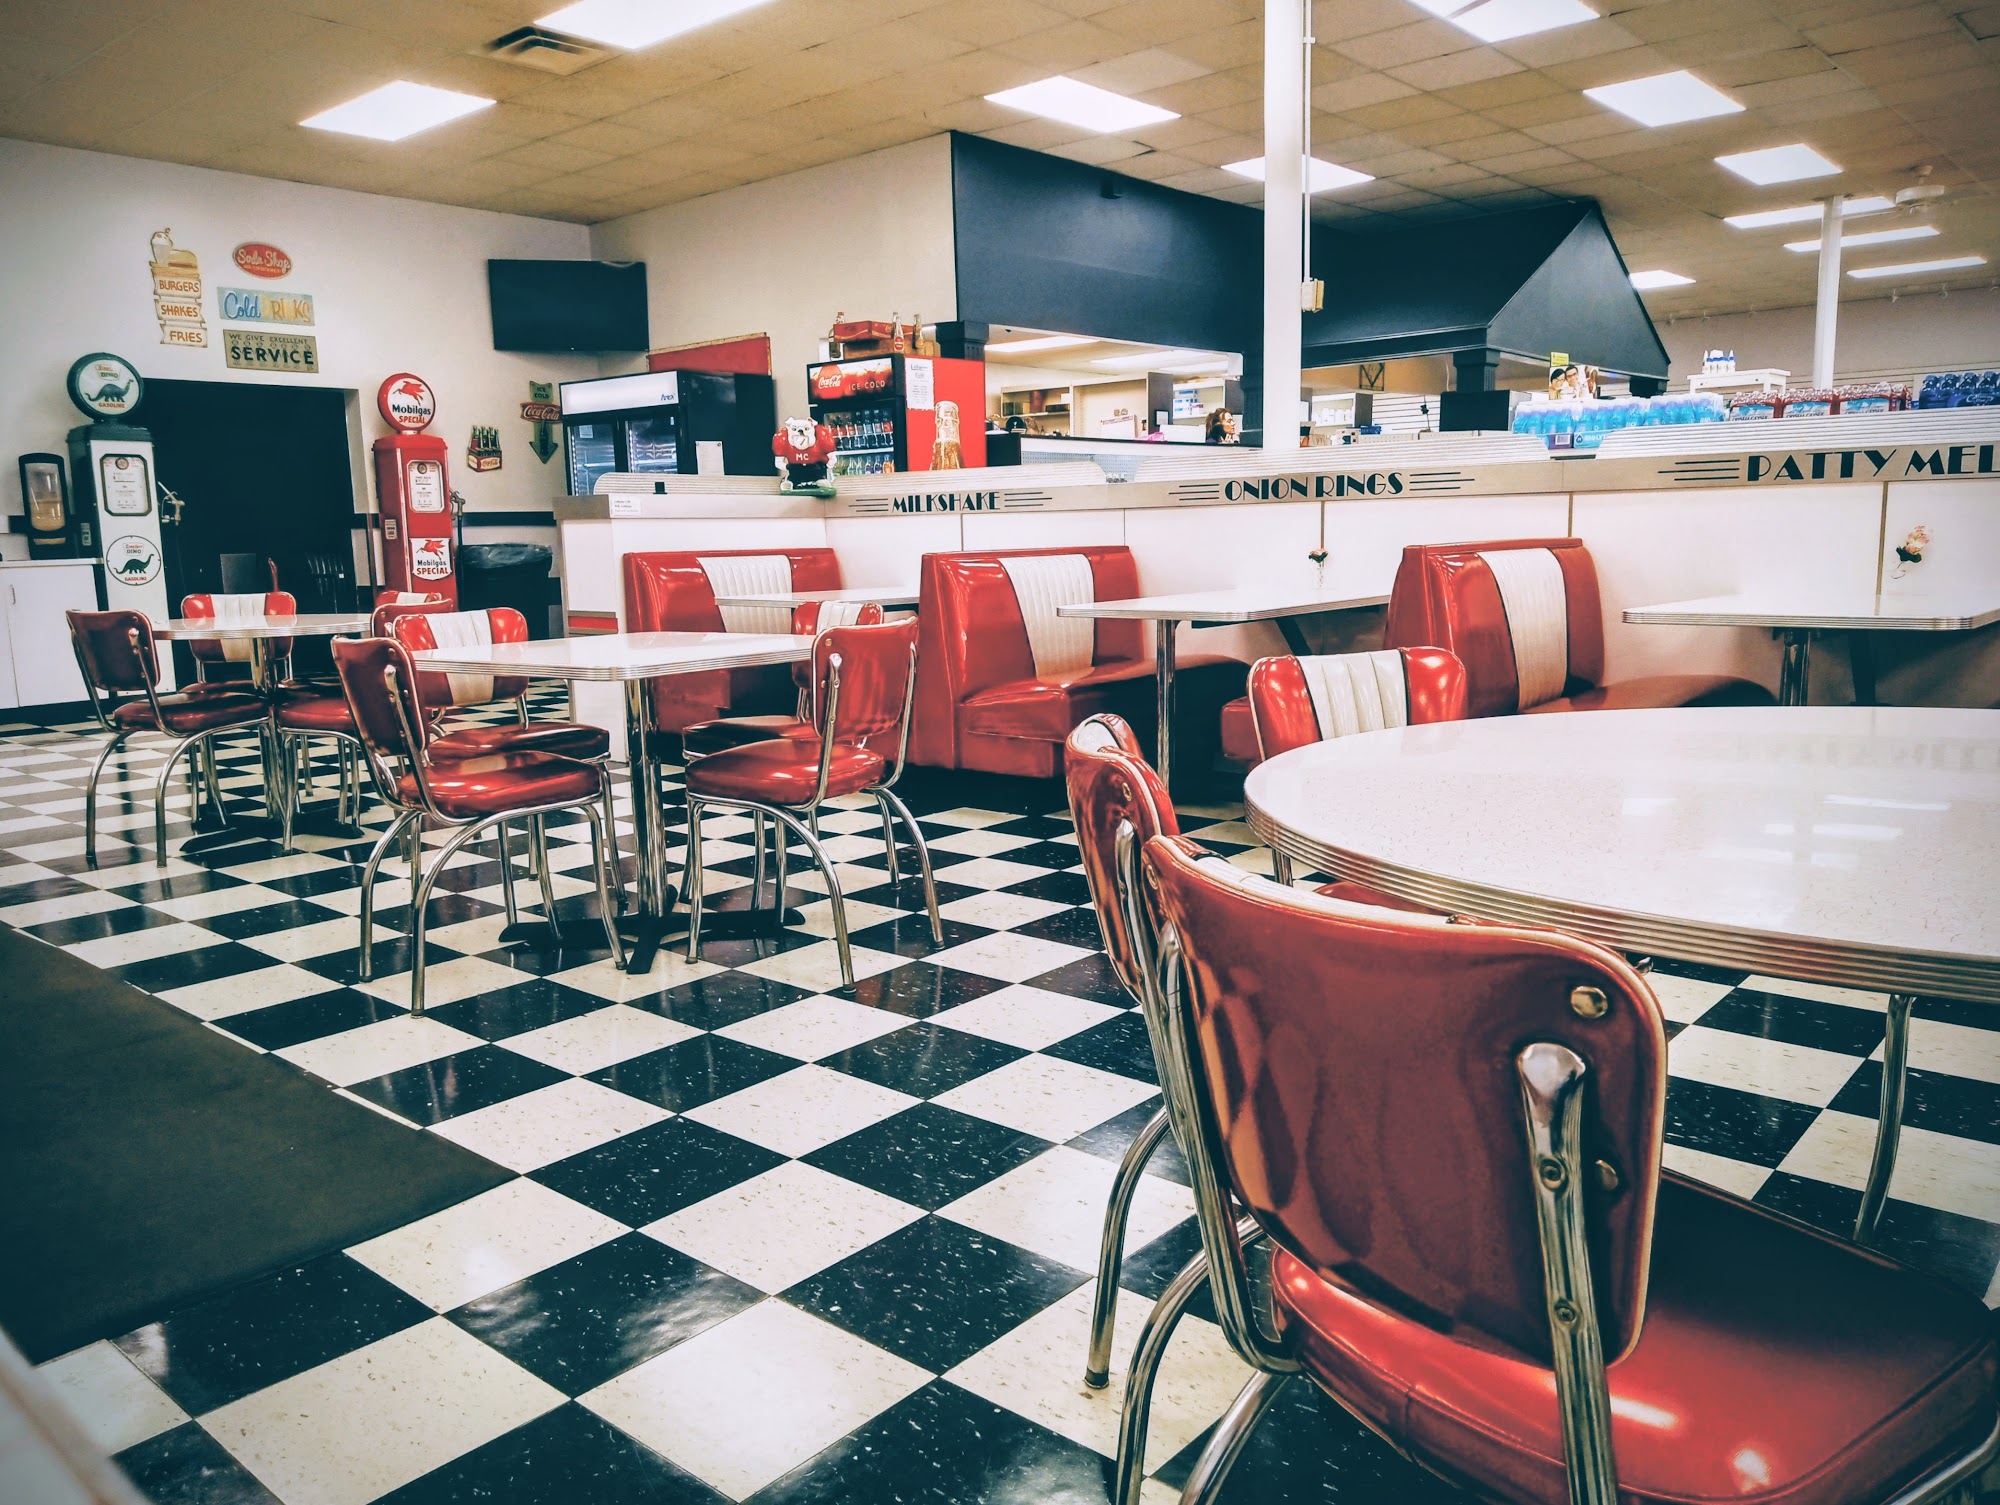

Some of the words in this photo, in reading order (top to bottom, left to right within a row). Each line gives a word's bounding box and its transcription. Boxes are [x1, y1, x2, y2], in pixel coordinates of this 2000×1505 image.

[237, 248, 263, 265] Soda
[264, 250, 291, 274] Shop
[159, 279, 200, 293] BURGERS
[161, 304, 198, 318] SHAKES
[224, 292, 261, 319] Cold
[261, 293, 312, 323] DRIKS
[169, 330, 203, 343] FRIES
[229, 333, 242, 341] WE
[246, 334, 265, 342] GIVE
[269, 336, 307, 345] EXCELLENT
[231, 345, 314, 365] SERVICE
[848, 383, 861, 391] ICE
[864, 380, 886, 390] COLD
[392, 404, 431, 416] Mobilgas
[399, 415, 425, 424] SPECIAL
[795, 453, 809, 461] MC
[1747, 449, 1897, 481] PATTY
[1225, 476, 1308, 501] ONION
[1315, 472, 1403, 498] RINGS
[892, 491, 1000, 513] MILKSHAKE
[417, 559, 446, 568] Mobilgas
[416, 567, 448, 575] SPECIAL
